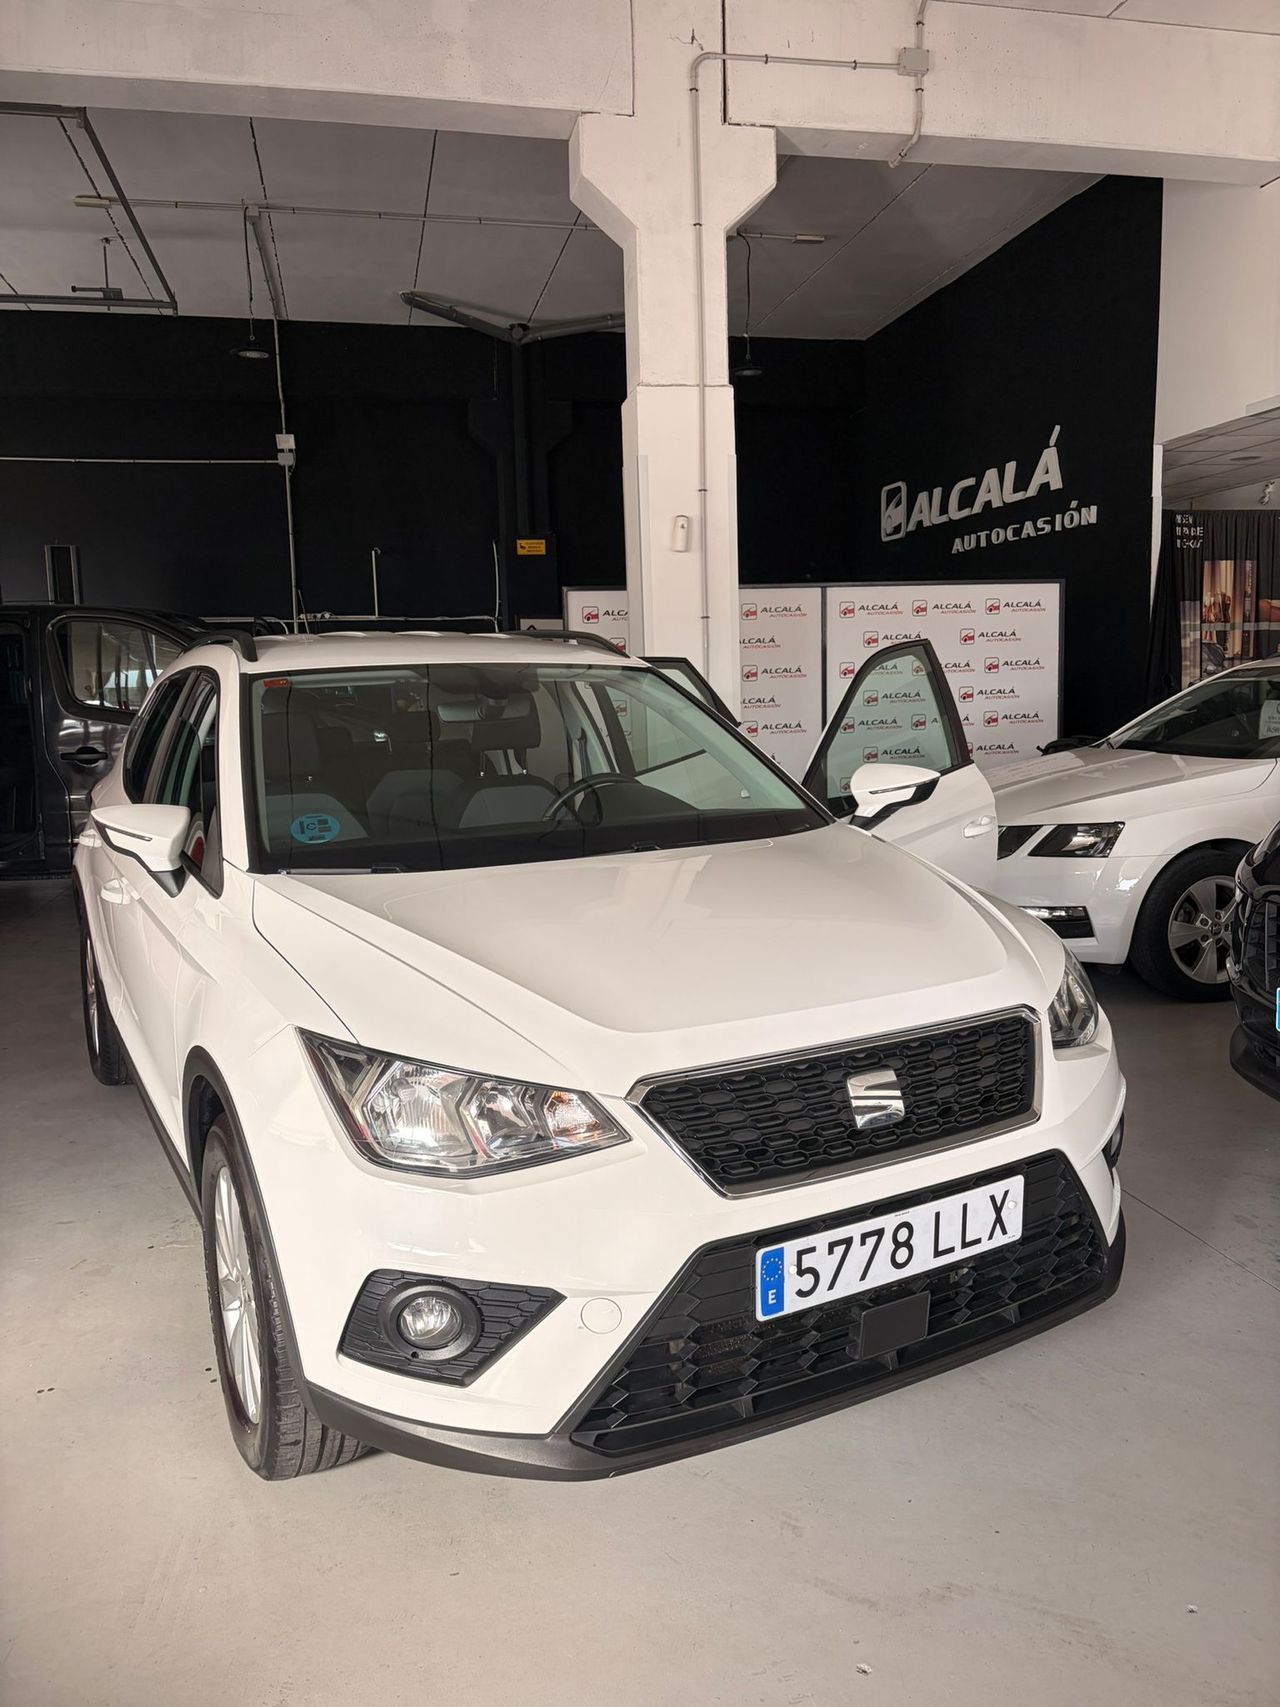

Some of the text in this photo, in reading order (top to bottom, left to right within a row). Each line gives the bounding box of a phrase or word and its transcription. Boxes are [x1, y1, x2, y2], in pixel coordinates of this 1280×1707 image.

[906, 425, 1063, 532] ALCALÁ
[951, 500, 1098, 554] AUTOCASIÓN
[760, 604, 802, 613] ALCALÁ
[858, 602, 898, 611] ALCALÁ
[932, 601, 972, 610] ALCALÁ
[1003, 600, 1042, 608] ALCALÁ
[881, 631, 922, 640] ALCALÁ
[978, 629, 1017, 638] ALCALÁ
[1002, 658, 1041, 667] ALCALÁ
[761, 665, 802, 674] ALCALÁ
[881, 690, 921, 699] ALCALÁ
[977, 687, 1016, 696] ALCALÁ
[1001, 711, 1040, 720] ALCALÁ
[761, 720, 802, 729] ALCALÁ
[857, 718, 898, 727] ALCALÁ
[881, 747, 921, 756] ALCALÁ
[976, 743, 1015, 751] ALCALÁ
[767, 1189, 1010, 1305] E 5778 LLX
